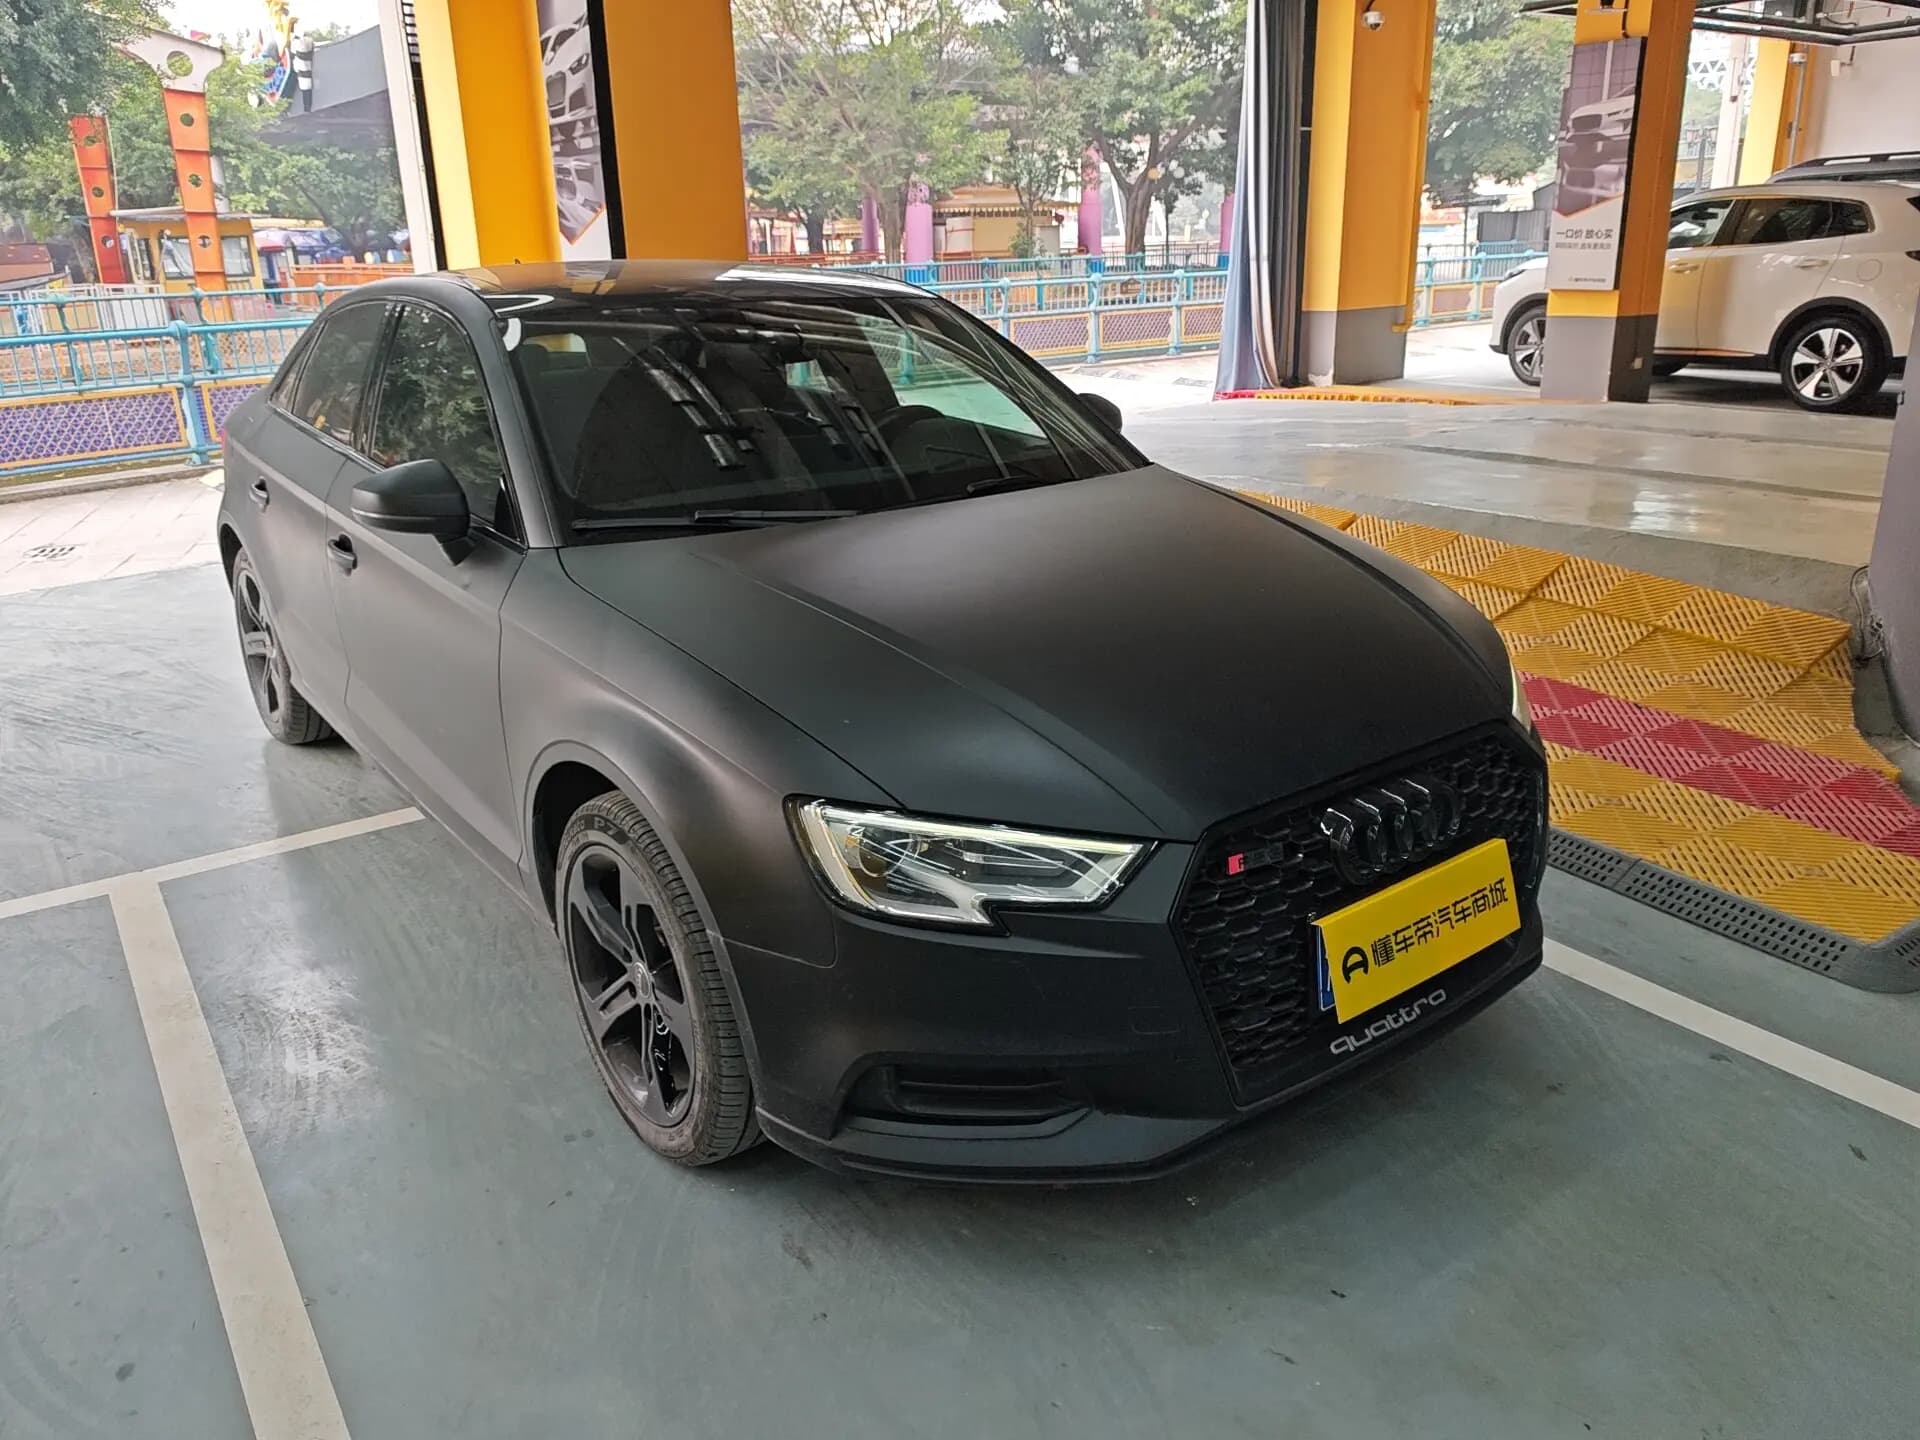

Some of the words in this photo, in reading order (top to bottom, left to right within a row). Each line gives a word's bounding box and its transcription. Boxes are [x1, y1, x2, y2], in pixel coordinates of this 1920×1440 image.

[1556, 229, 1583, 239] 一口价
[1585, 228, 1613, 239] 放心买
[1371, 877, 1508, 967] 懂车帝汽车商城
[1330, 989, 1446, 1054] quattro
